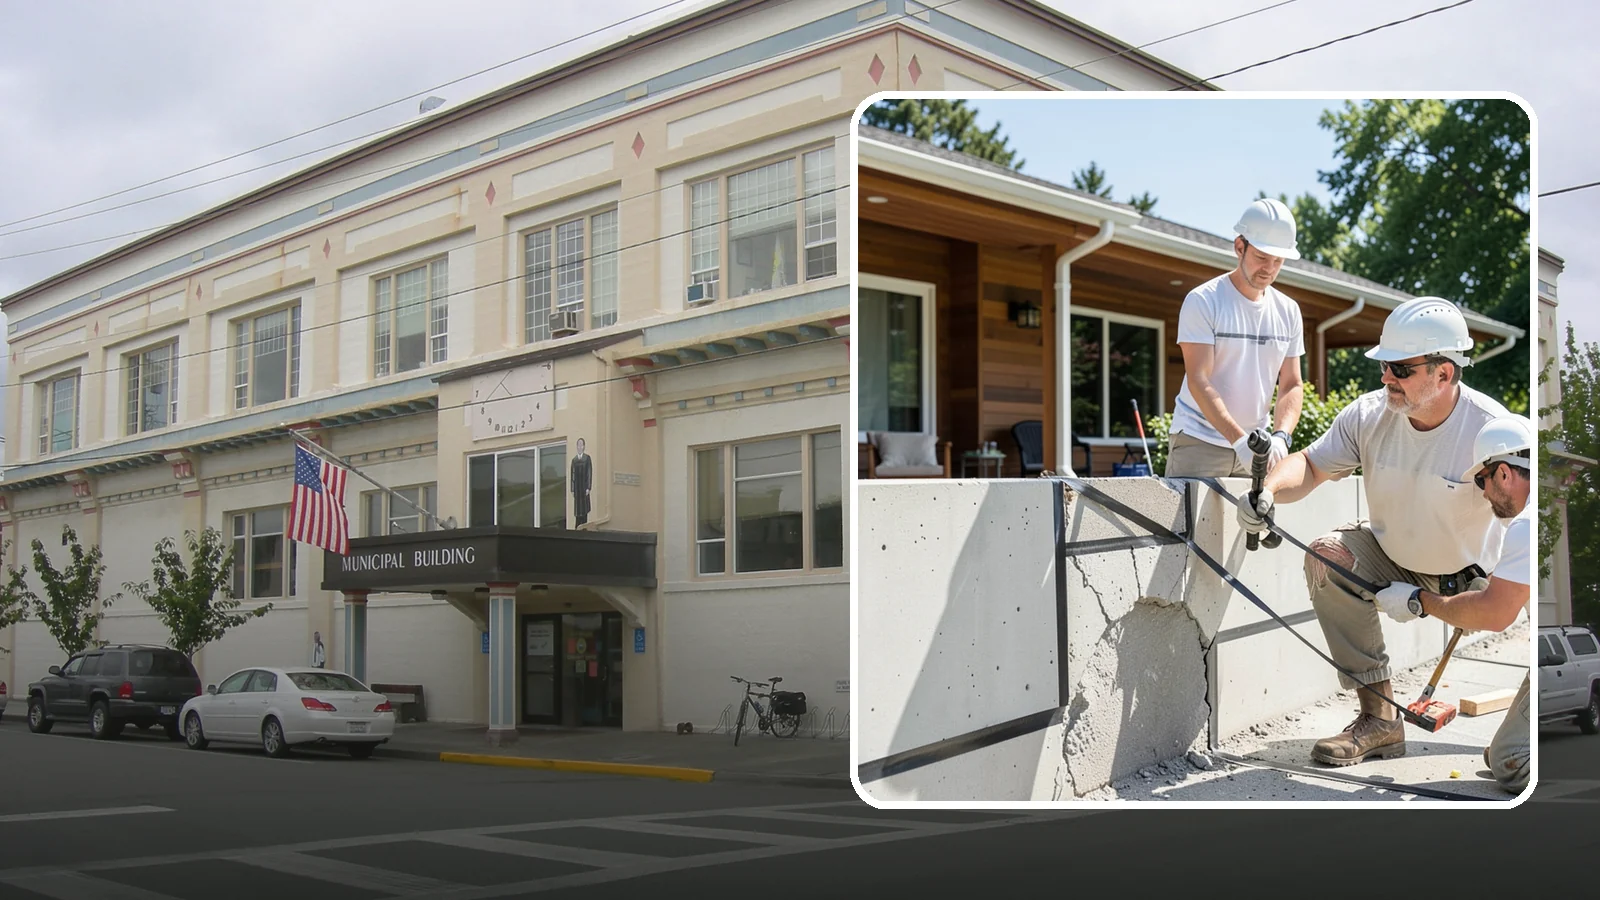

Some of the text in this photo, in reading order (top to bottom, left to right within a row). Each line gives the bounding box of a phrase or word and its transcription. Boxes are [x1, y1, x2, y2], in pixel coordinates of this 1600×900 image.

[475, 390, 479, 398] 7
[536, 402, 540, 410] 4
[481, 407, 485, 415] 8
[488, 417, 492, 425] 9
[529, 414, 533, 422] 3
[521, 420, 525, 428] 2
[508, 425, 513, 433] 12
[342, 546, 475, 572] MUNICIPAL BUILDING
